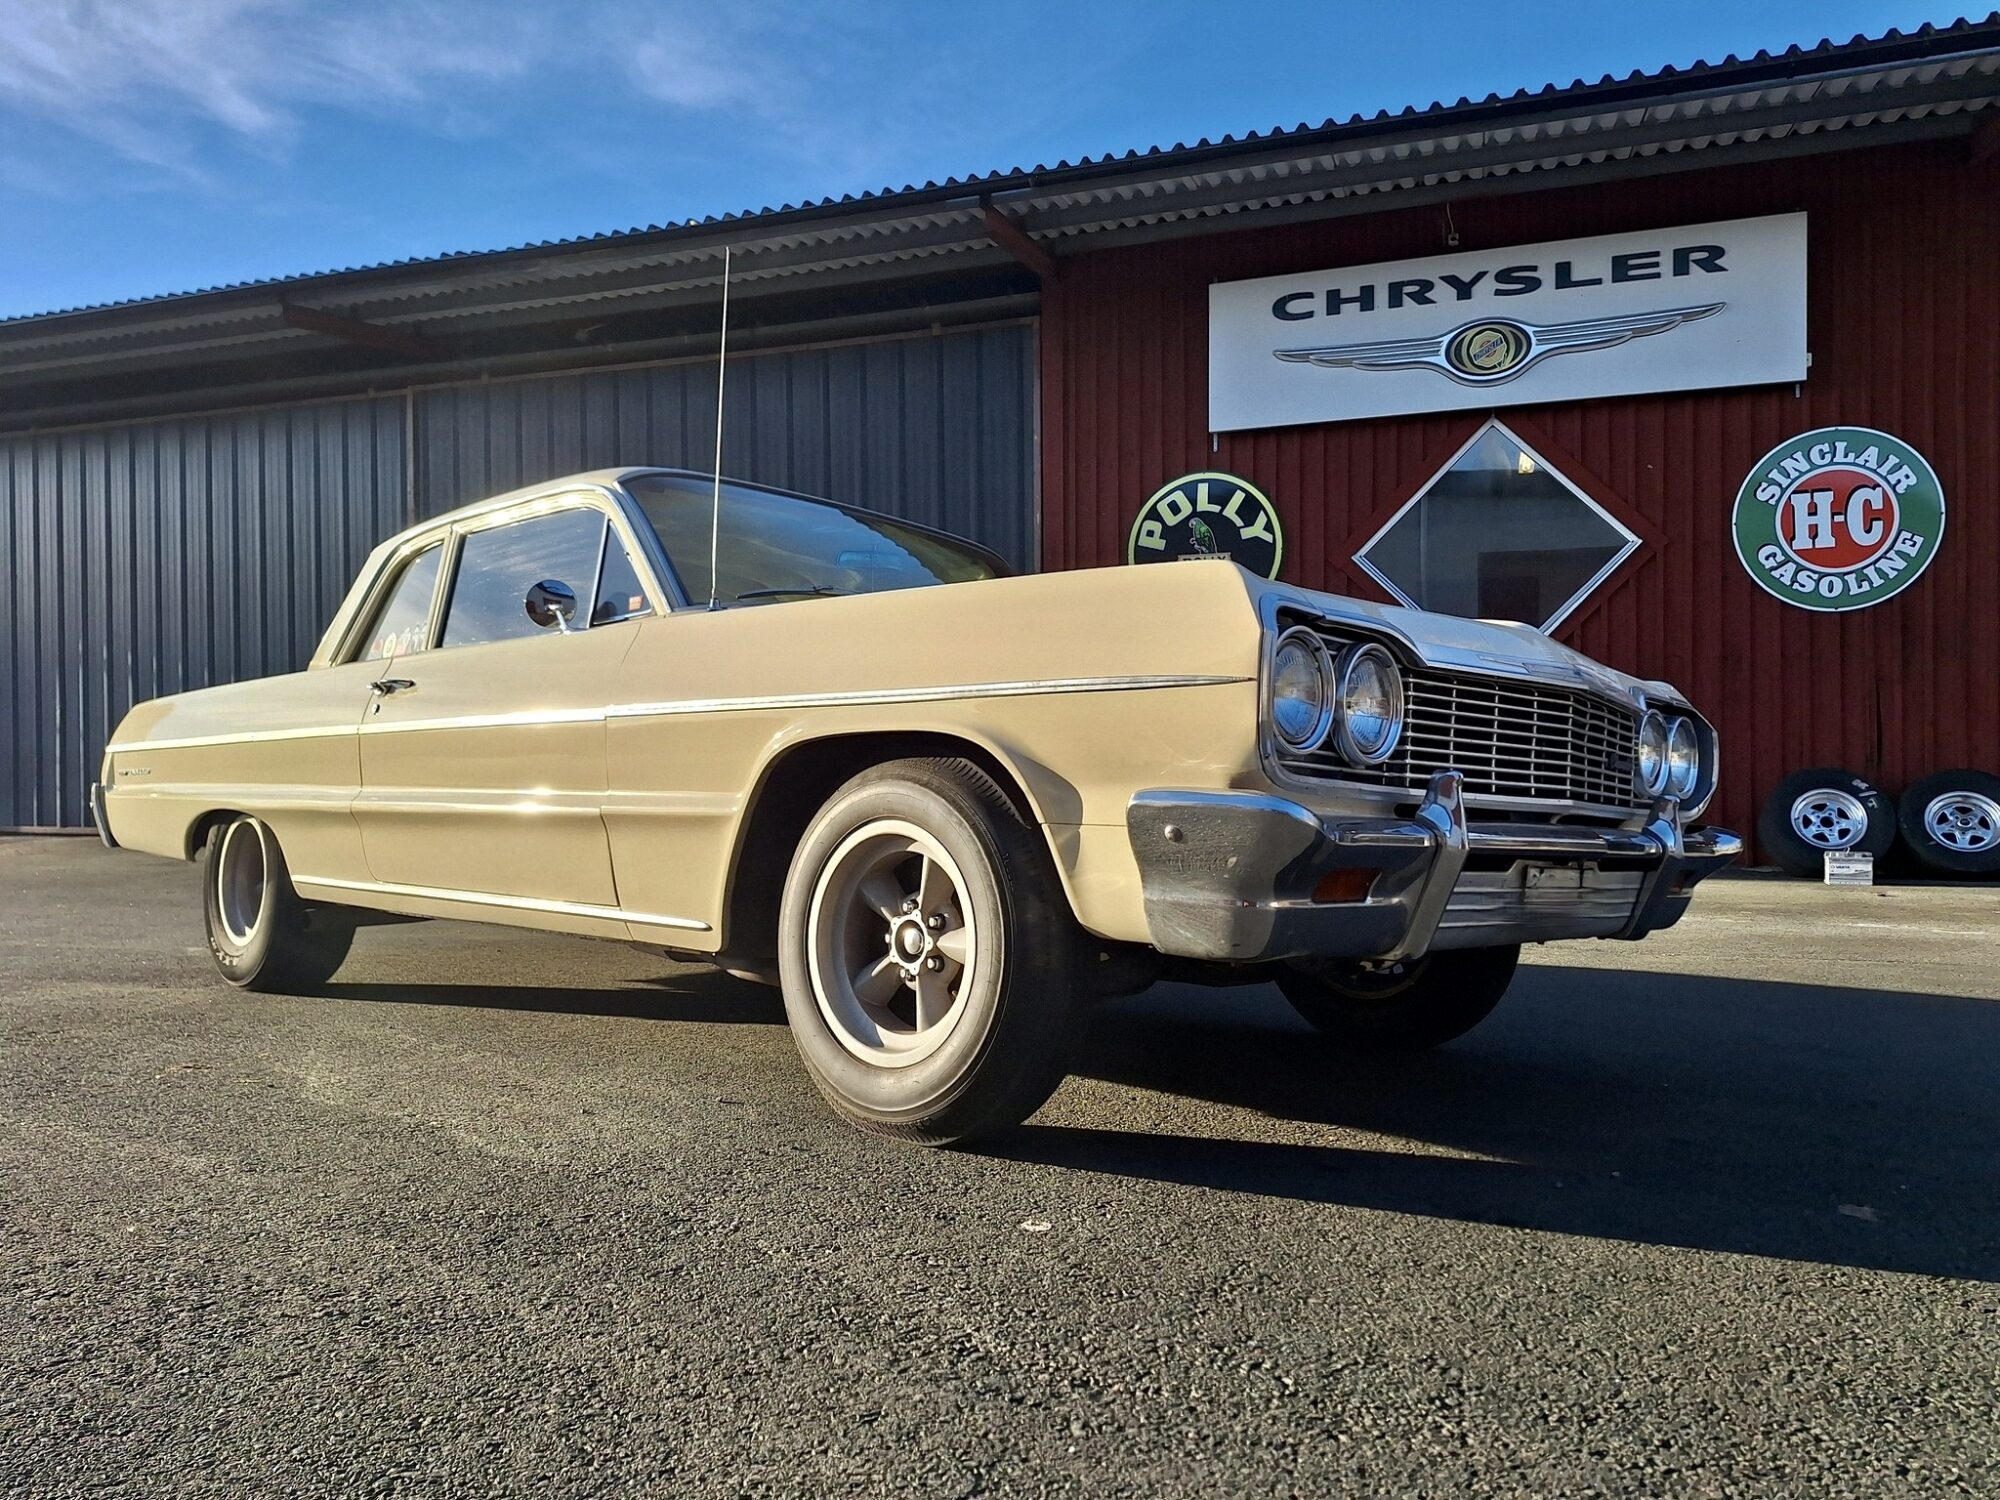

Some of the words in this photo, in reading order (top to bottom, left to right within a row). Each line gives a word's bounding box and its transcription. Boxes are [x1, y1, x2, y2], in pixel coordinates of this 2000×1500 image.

[1272, 244, 1729, 322] CHRYSLER
[1755, 441, 1918, 505] SINCLAIR
[1137, 482, 1274, 551] POLLY
[1790, 485, 1885, 551] H-C
[1757, 530, 1925, 598] GASOLINE
